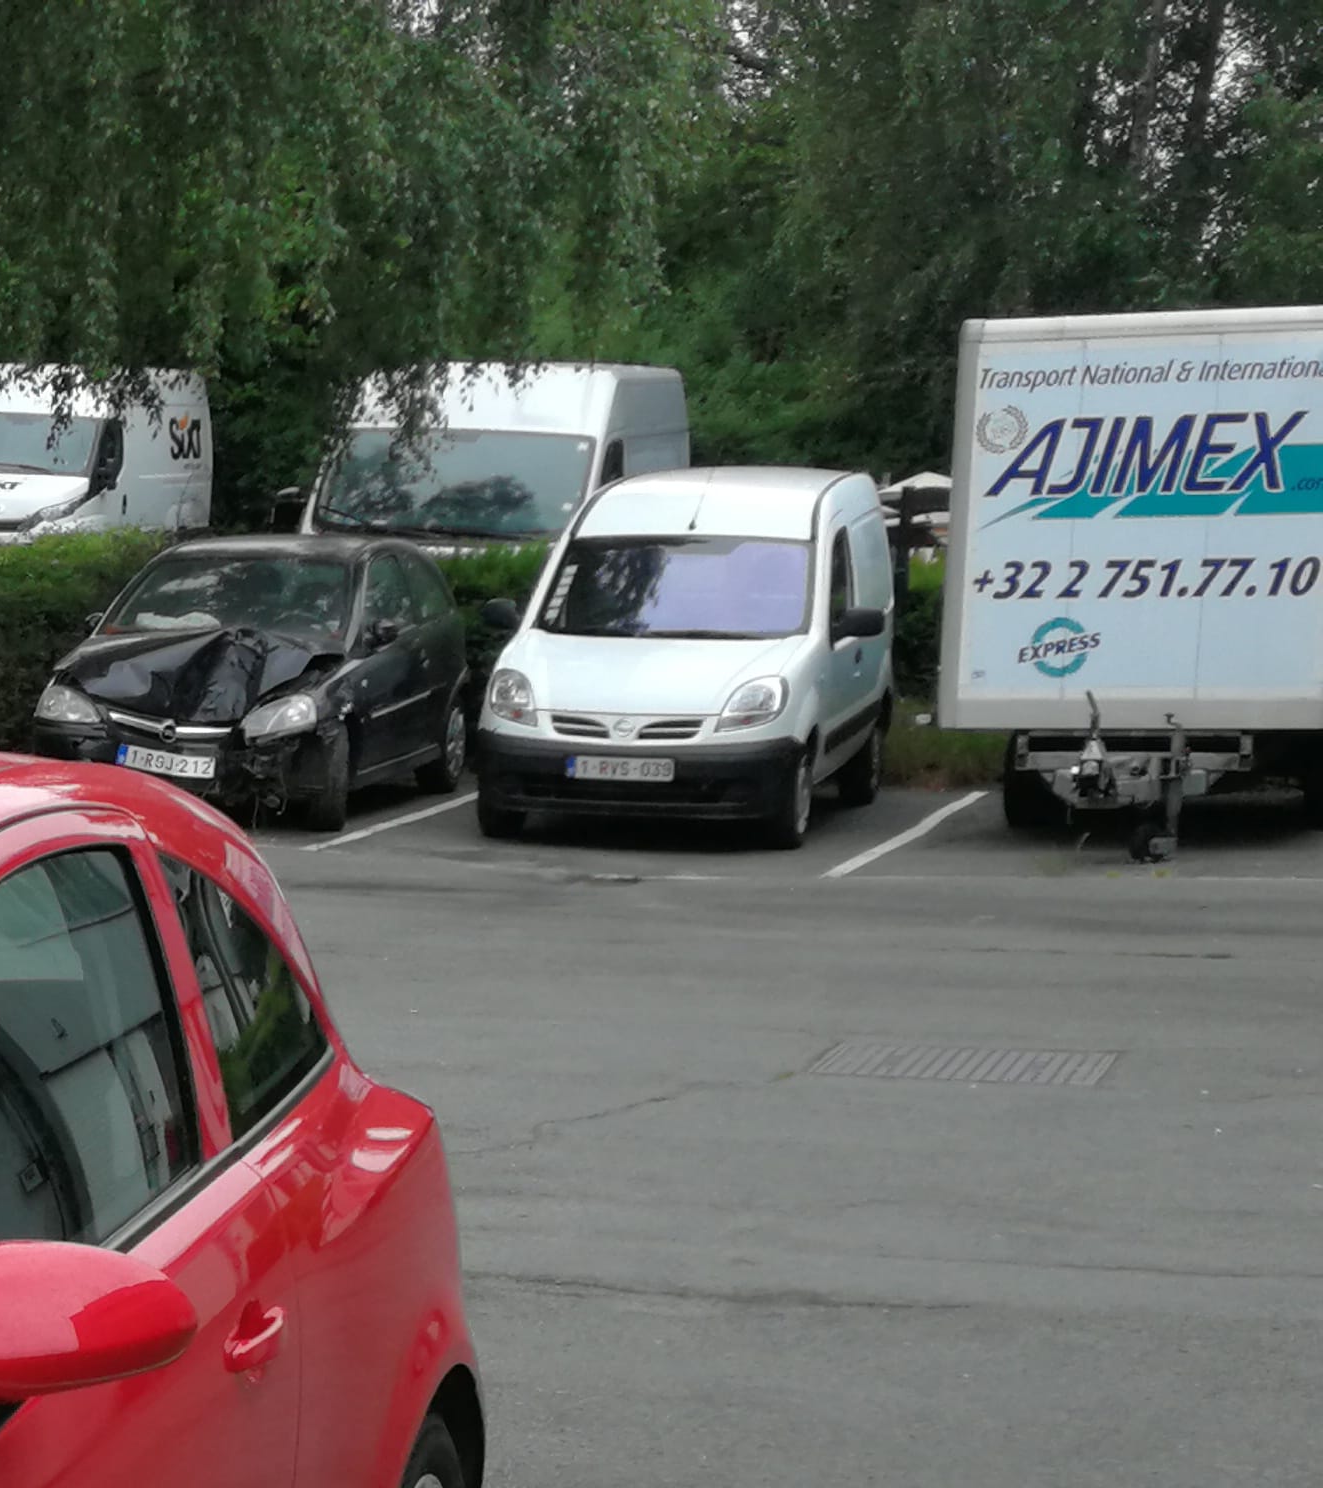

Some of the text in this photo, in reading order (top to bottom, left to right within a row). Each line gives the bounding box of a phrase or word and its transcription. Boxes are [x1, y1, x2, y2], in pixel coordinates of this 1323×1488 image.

[979, 365, 1077, 393] Transport
[1080, 358, 1175, 386] National
[1176, 360, 1194, 383] &
[984, 410, 1309, 498] AJIMEX
[973, 555, 1322, 600] +32 2 751.77.10
[1017, 631, 1102, 665] EXPRESS
